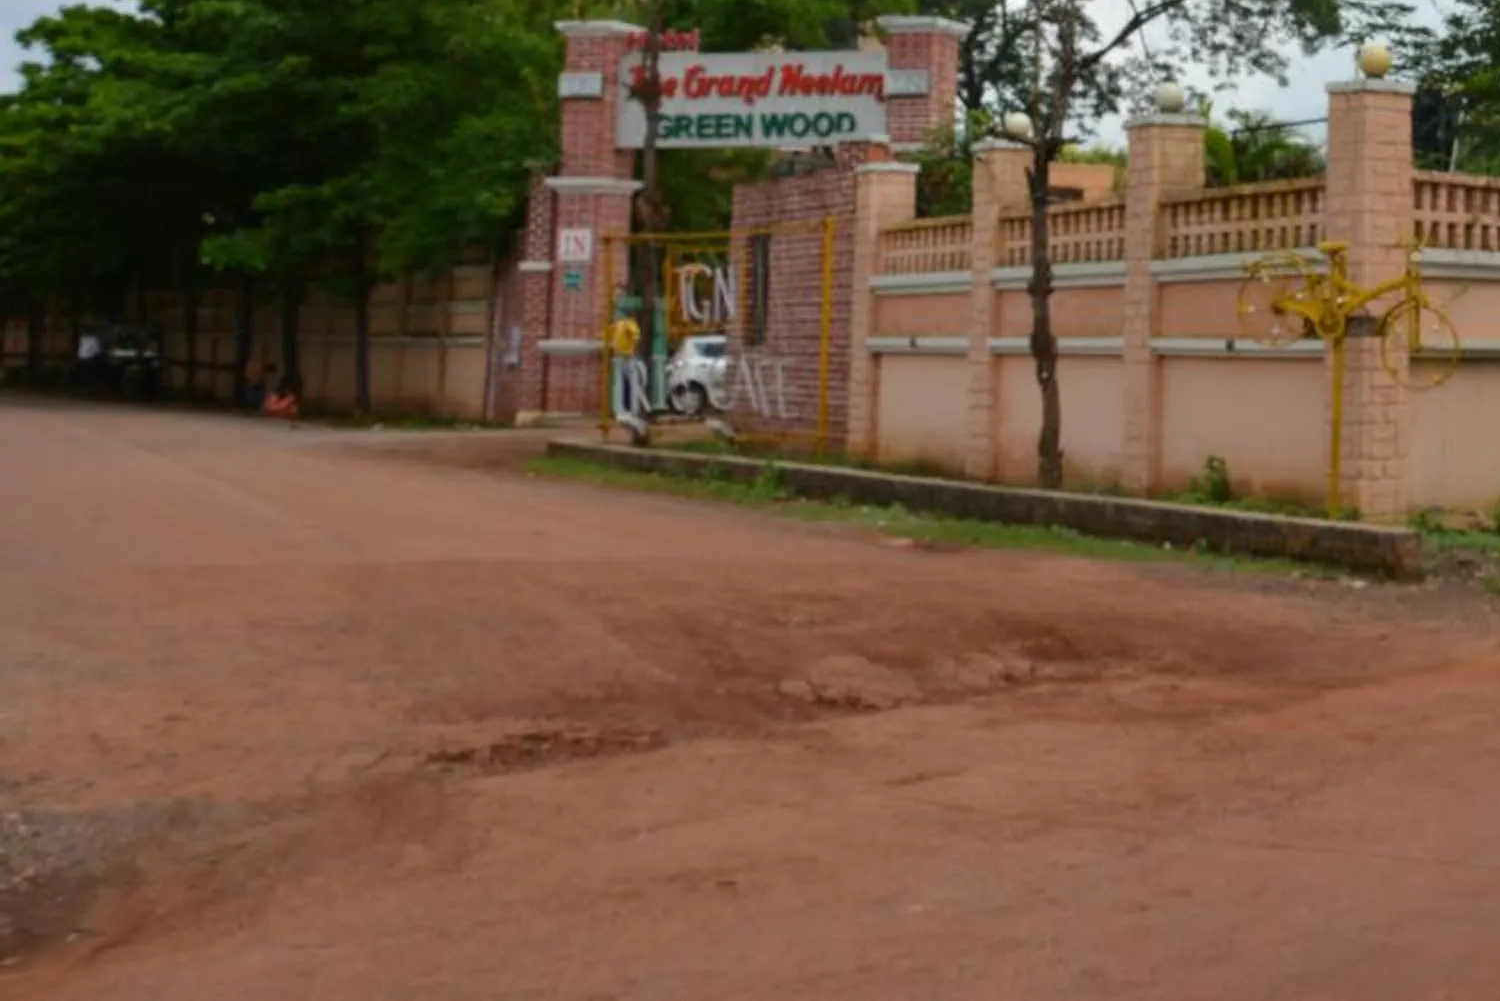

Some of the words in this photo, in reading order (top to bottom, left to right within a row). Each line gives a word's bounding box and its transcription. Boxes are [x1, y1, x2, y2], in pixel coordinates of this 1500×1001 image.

[684, 64, 774, 105] Grand
[778, 63, 886, 102] Neelam
[654, 113, 753, 139] GREEN
[760, 112, 856, 138] WOOD
[562, 233, 588, 257] IN
